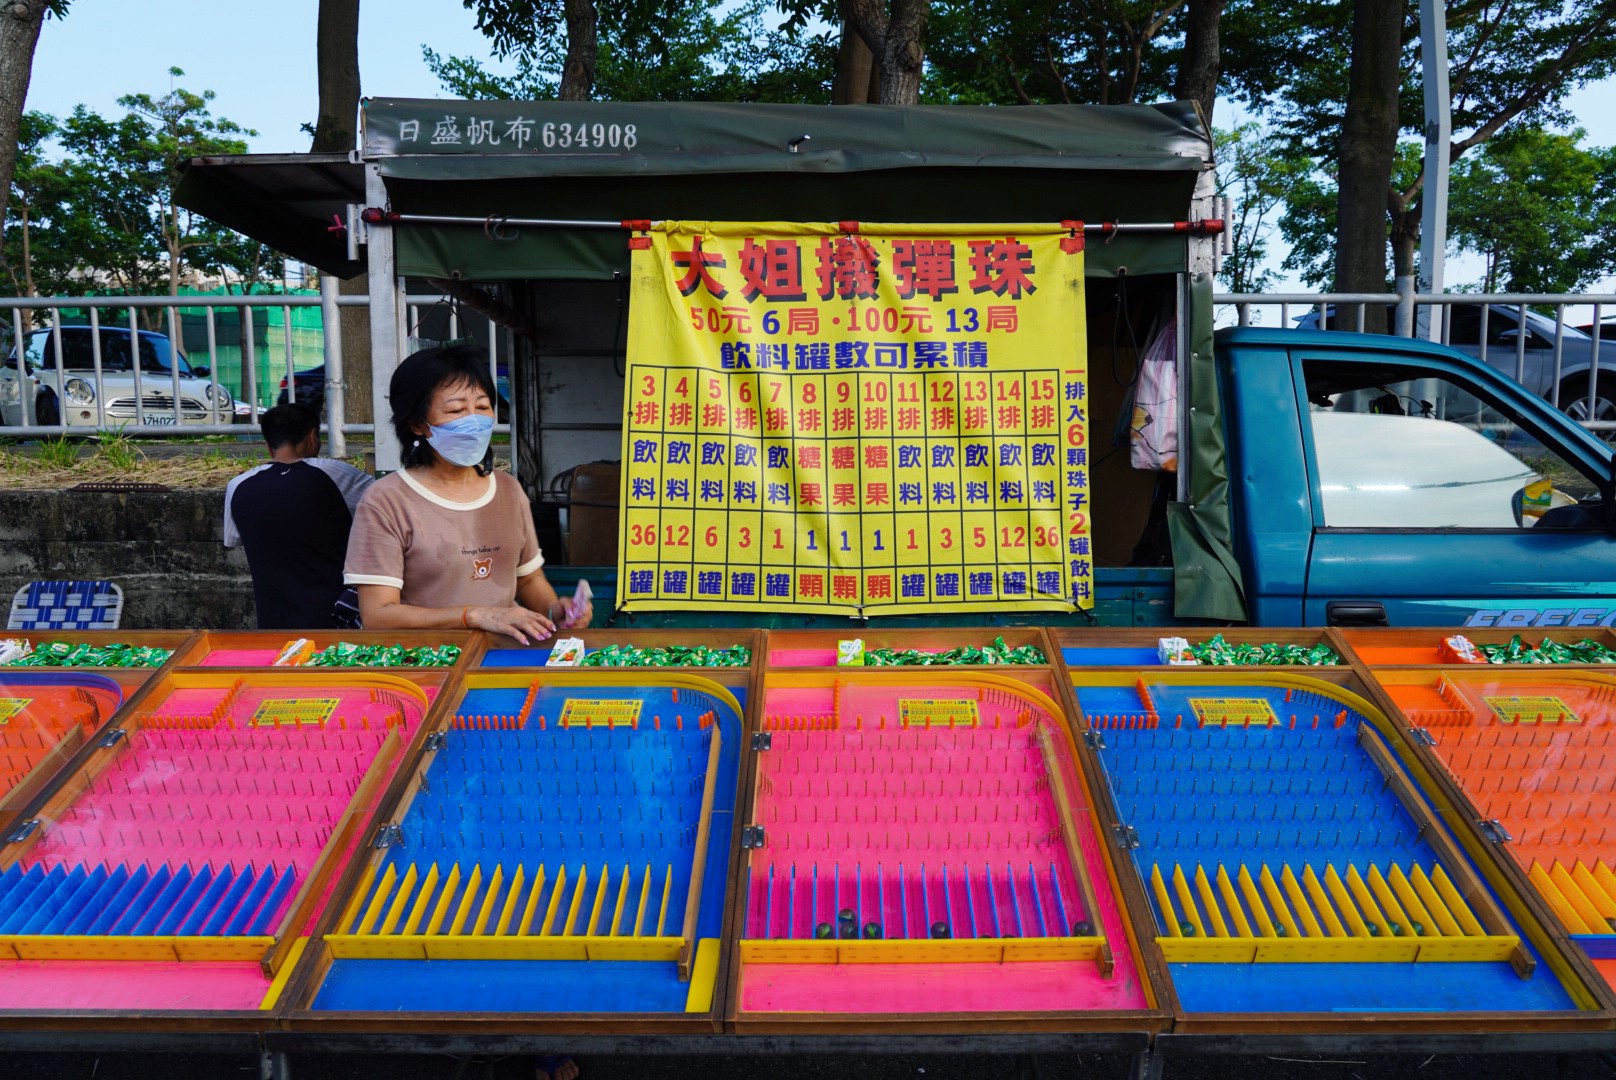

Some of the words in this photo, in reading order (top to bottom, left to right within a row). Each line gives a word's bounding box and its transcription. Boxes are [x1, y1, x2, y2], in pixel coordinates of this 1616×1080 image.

[399, 116, 535, 149] 日盛帆布
[542, 122, 638, 148] 634908
[671, 235, 1034, 300] 大姐撥彈珠
[720, 341, 988, 371] 飲料罐數可累積
